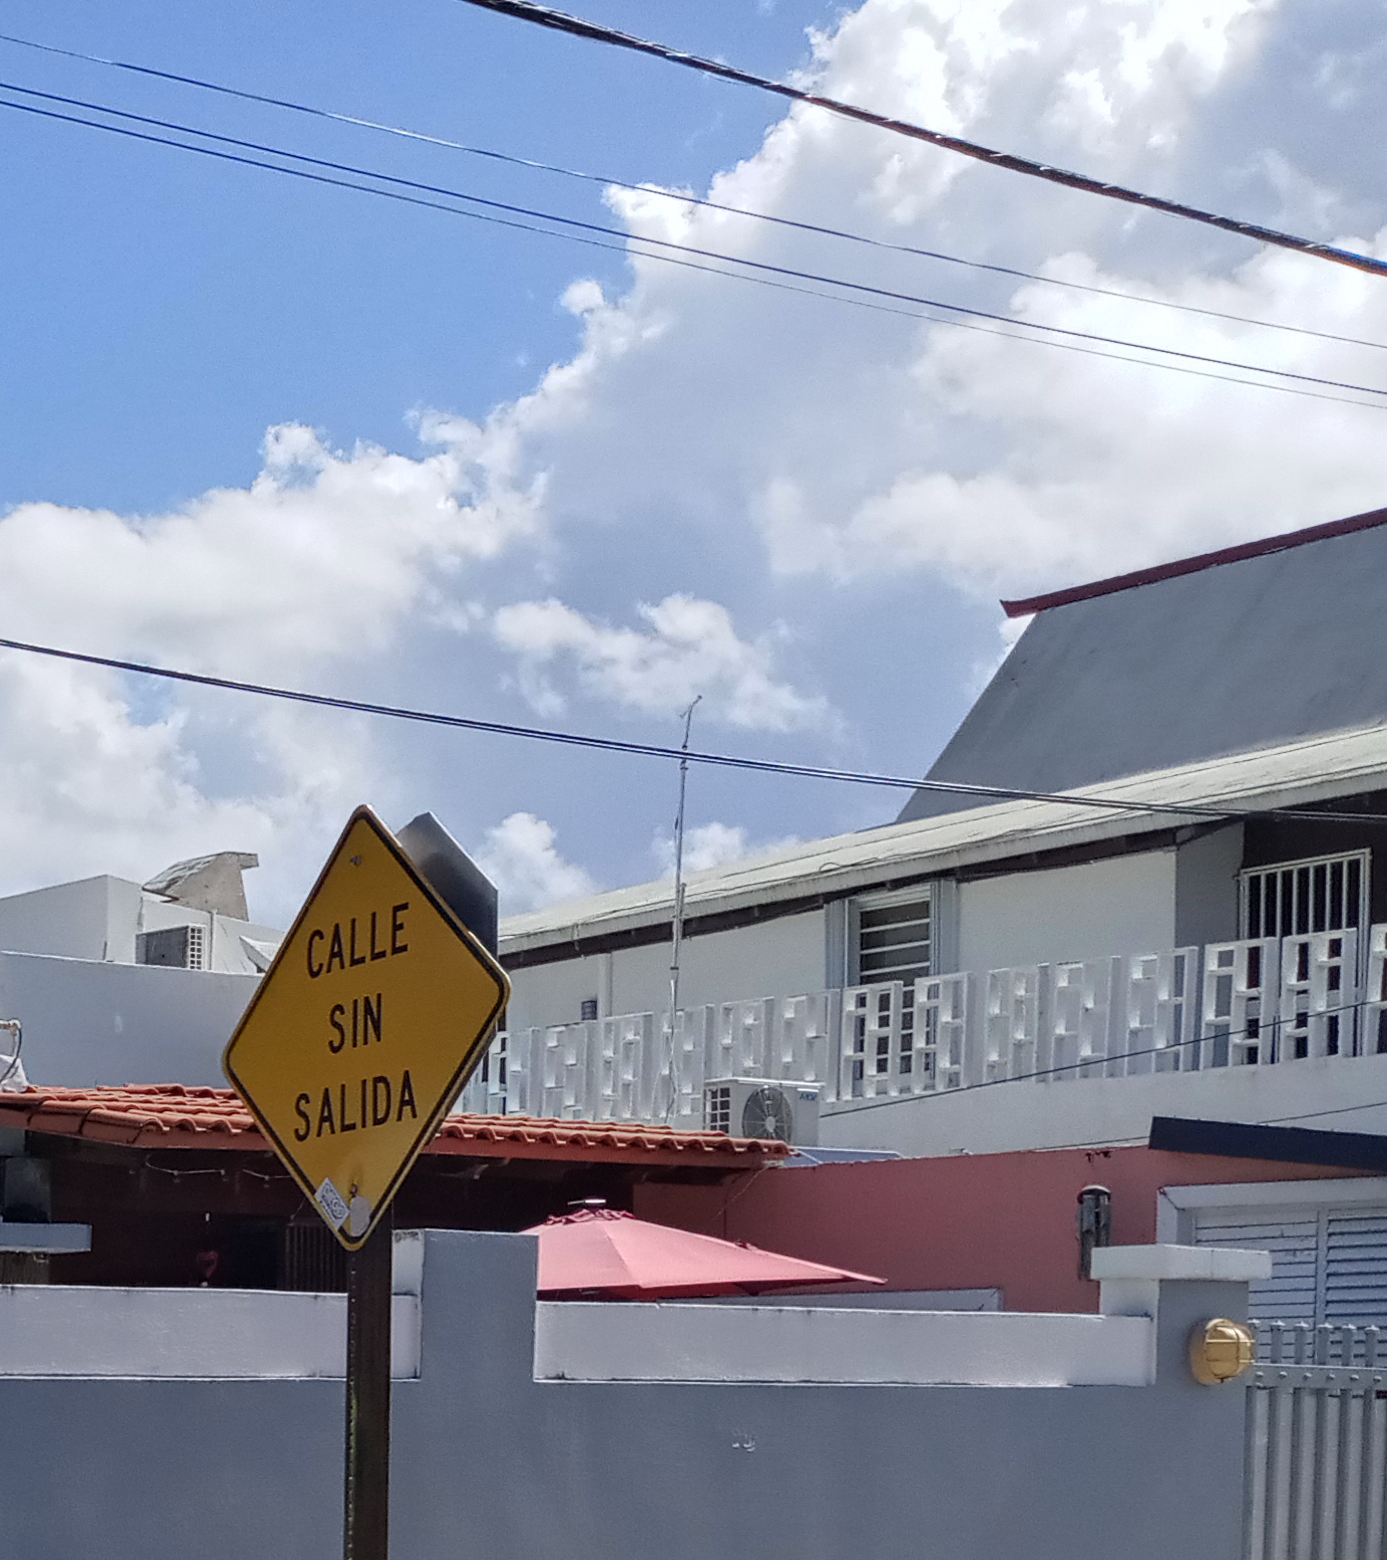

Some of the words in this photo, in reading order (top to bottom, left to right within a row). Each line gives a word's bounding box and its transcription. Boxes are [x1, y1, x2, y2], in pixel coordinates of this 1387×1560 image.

[307, 902, 410, 979] CALLE
[328, 993, 382, 1054] SIN
[294, 1069, 418, 1142] SALIDA
